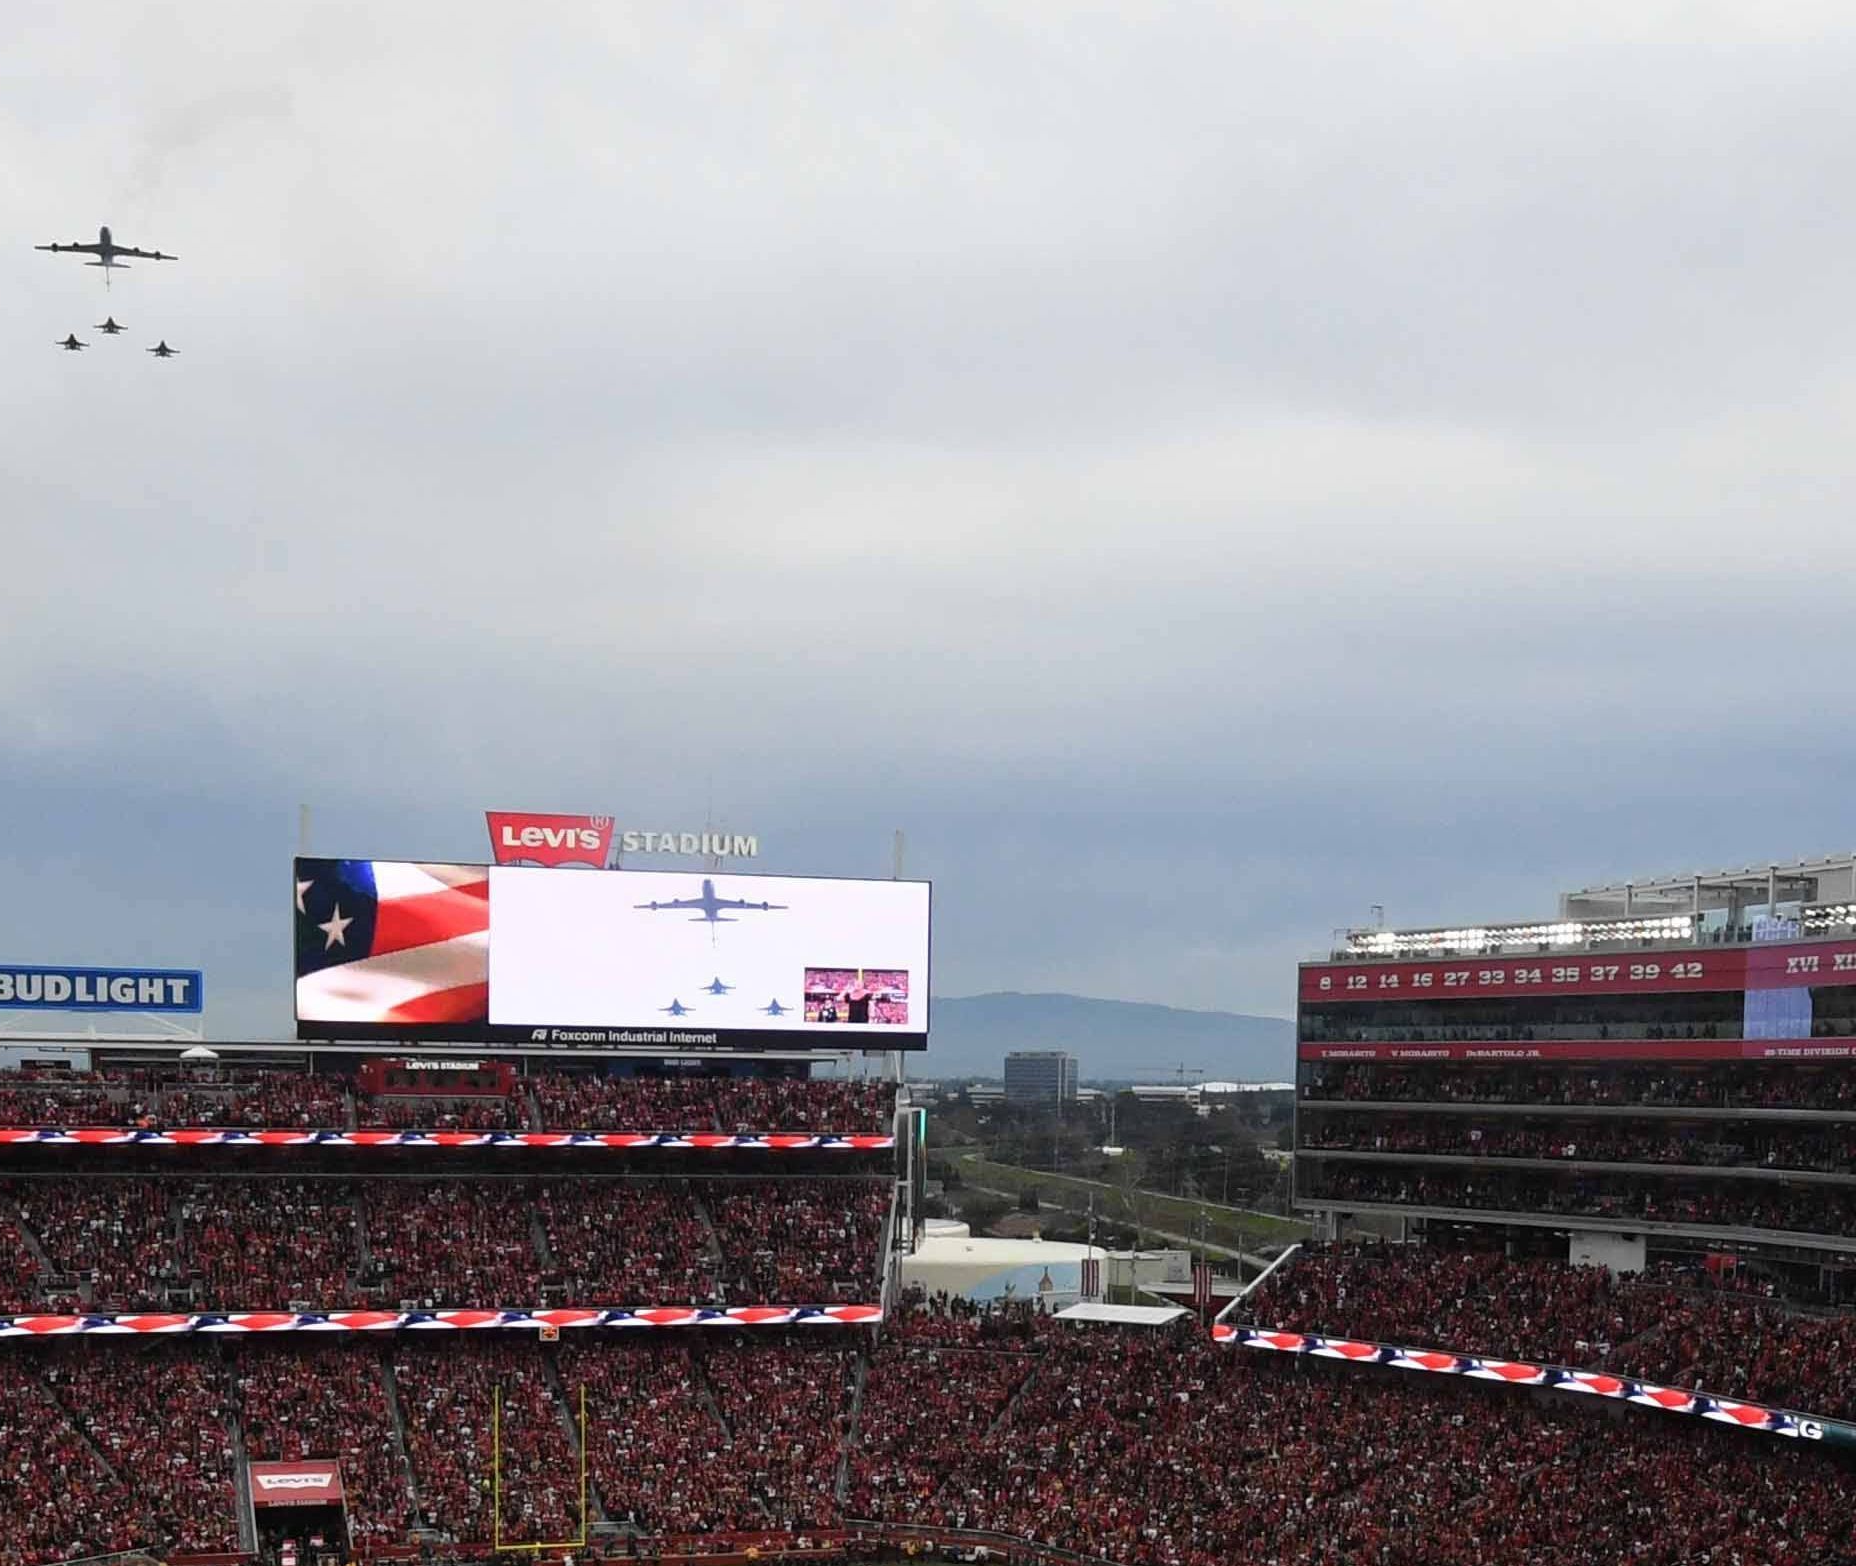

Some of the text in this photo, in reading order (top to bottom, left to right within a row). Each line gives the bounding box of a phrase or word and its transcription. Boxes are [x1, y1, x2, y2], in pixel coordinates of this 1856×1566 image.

[621, 831, 759, 857] STADIUM
[1318, 962, 1703, 991] 8 12 14 16 27 33 34 35 37 39 42
[75, 976, 190, 1005] LIGHT
[552, 1029, 606, 1042] Foxconn
[608, 1030, 667, 1043] Industrial
[669, 1031, 718, 1044] Internet
